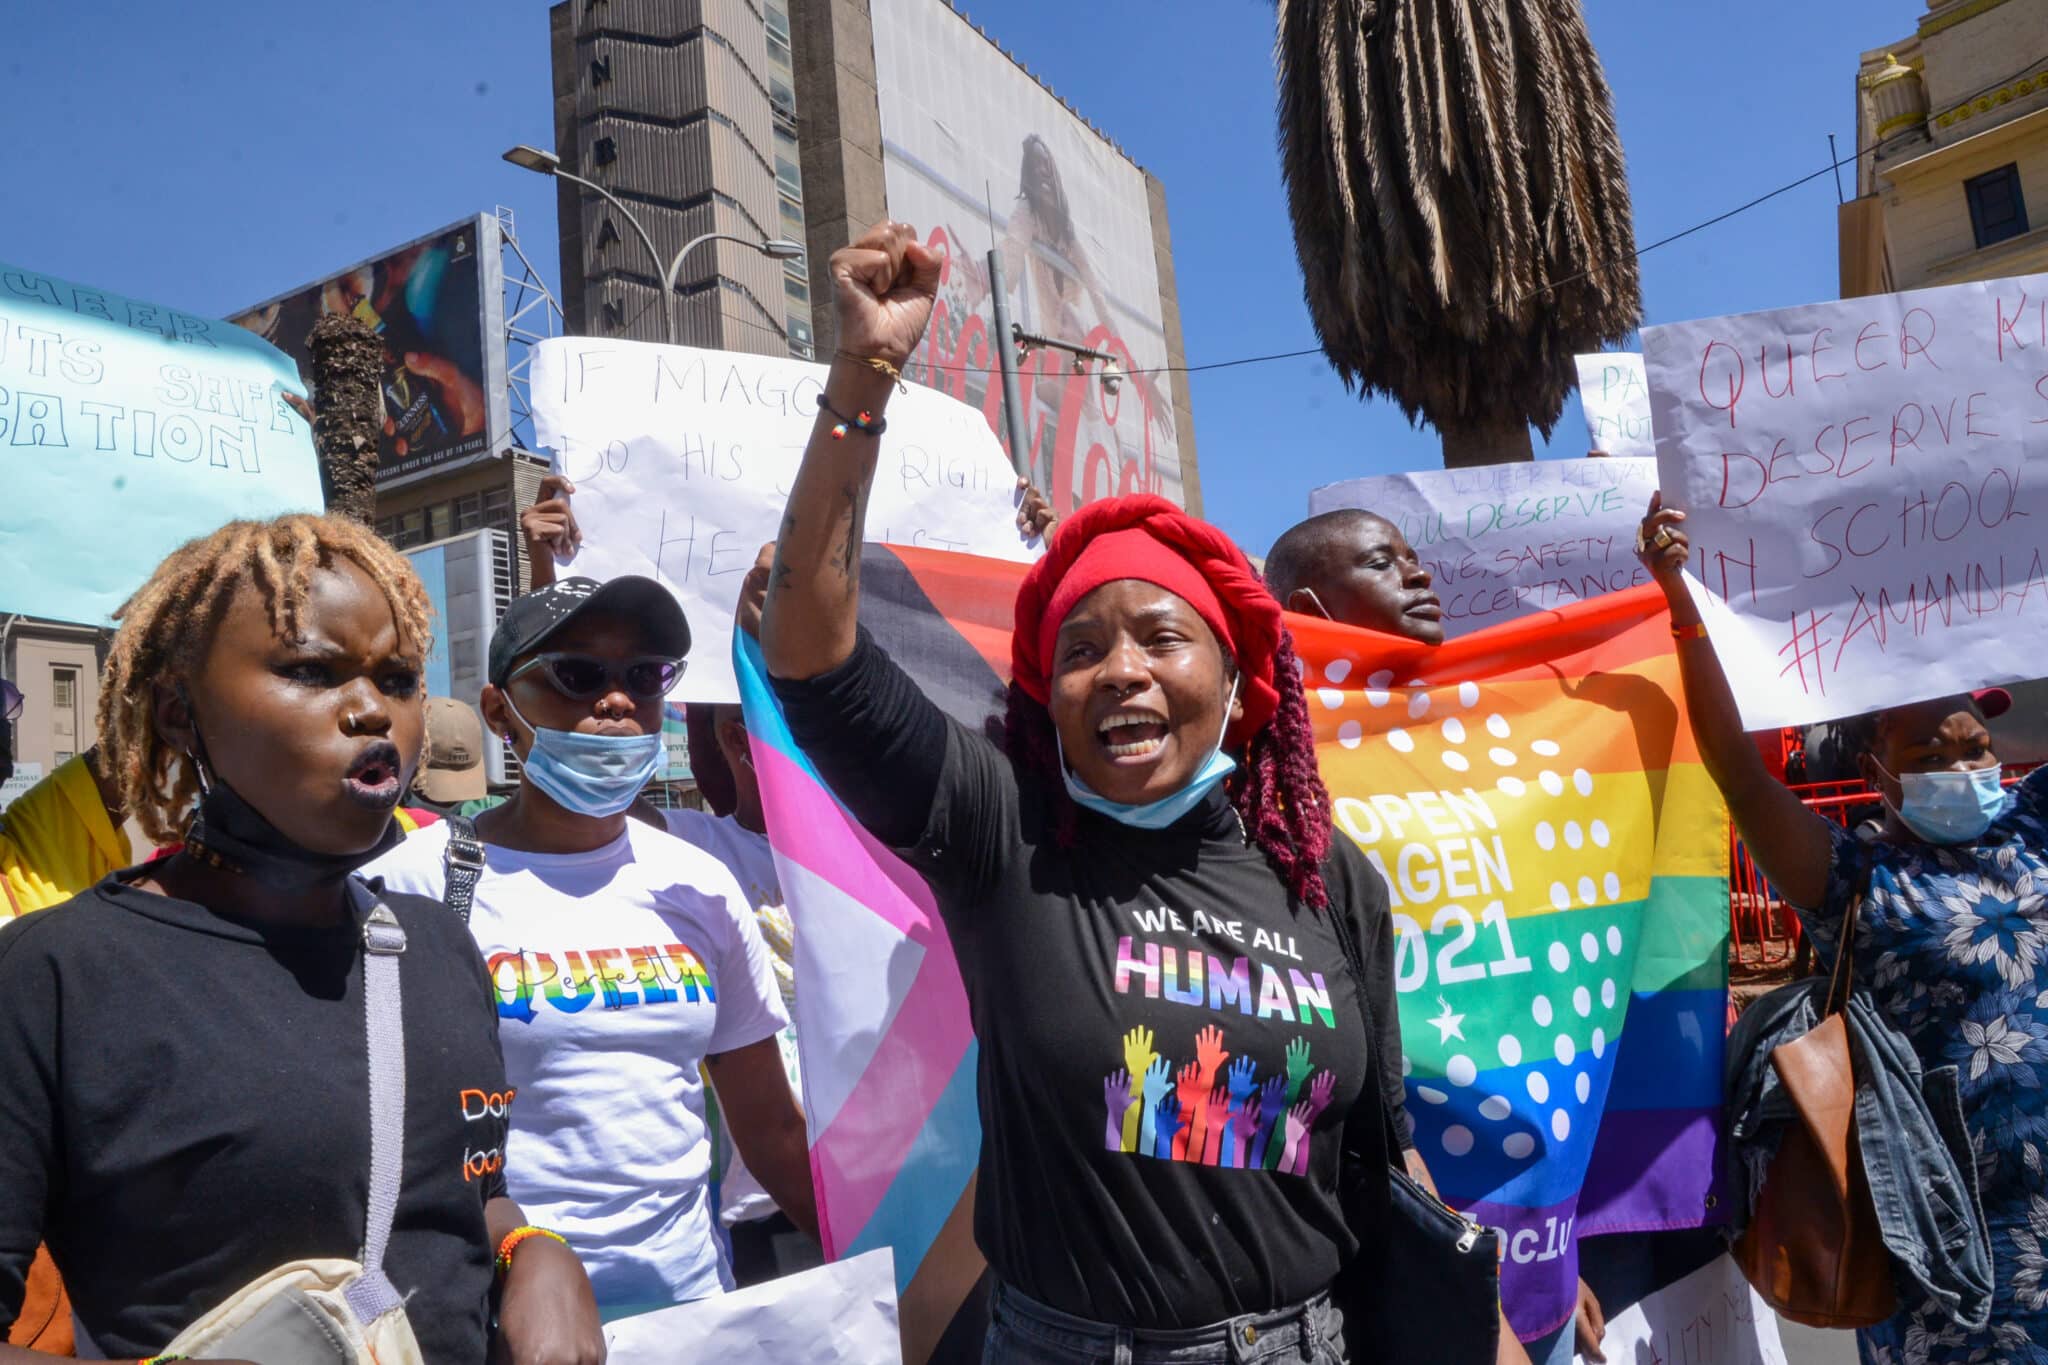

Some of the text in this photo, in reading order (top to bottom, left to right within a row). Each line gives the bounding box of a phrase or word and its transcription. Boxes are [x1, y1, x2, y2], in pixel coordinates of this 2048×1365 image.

[0, 318, 294, 435] TS SAFE
[562, 346, 616, 405] IF
[1700, 307, 1942, 430] QUEER
[681, 431, 745, 482] HIS
[1719, 392, 2000, 510] DESERVE
[1465, 486, 1625, 541] DESERVE
[1700, 468, 2030, 604] IN SCHOOL
[1493, 535, 1614, 579] SAFETY
[1132, 906, 1304, 960] WE ARE ALL
[487, 943, 717, 1025] QUEER
[1113, 935, 1337, 1030] HUMAN
